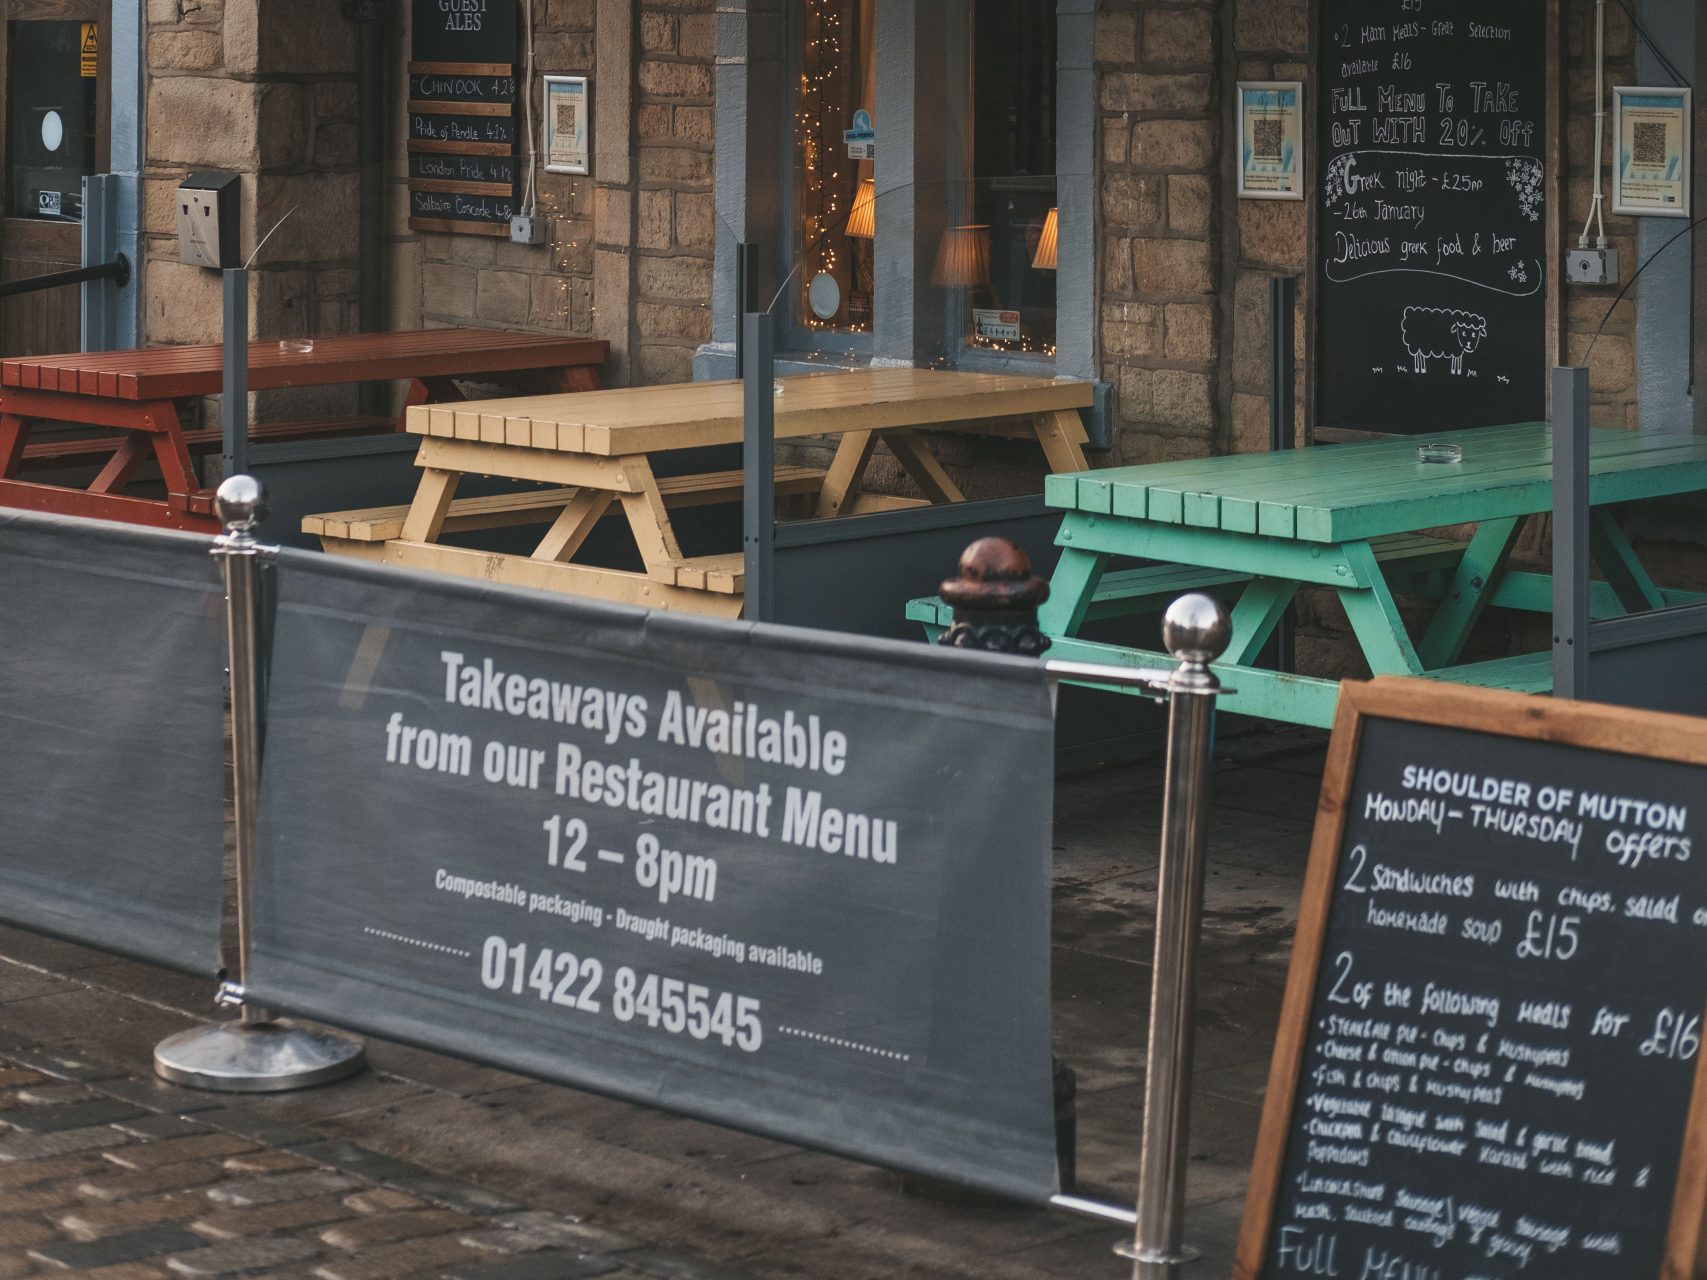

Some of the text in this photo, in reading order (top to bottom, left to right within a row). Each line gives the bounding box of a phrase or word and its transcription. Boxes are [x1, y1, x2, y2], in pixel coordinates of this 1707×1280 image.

[445, 13, 482, 31] ALES
[1341, 24, 1351, 48] 2
[1341, 51, 1412, 79] available £16
[1378, 84, 1426, 113] MENU
[1470, 82, 1520, 113] TAKE
[415, 116, 436, 137] Pride
[1372, 116, 1425, 144] WITH
[1439, 117, 1486, 146] 20%
[420, 156, 454, 176] London
[1374, 199, 1425, 229] January
[1333, 230, 1390, 263] Delicious
[1472, 232, 1482, 256] &
[440, 651, 847, 776] Takeaways Available
[385, 713, 898, 864] from our Restaurant Menu
[1402, 764, 1687, 833] SHOULDER OF MUTTON
[542, 815, 588, 872] 12
[634, 832, 718, 903] 8pm
[1344, 844, 1367, 893] 2
[1494, 880, 1540, 902] with
[435, 868, 823, 975] Compostable packaging Draught packaging available
[1516, 909, 1581, 961] £15
[480, 935, 763, 1053] 01422 845545
[1328, 950, 1353, 1004] 2
[1353, 982, 1374, 1010] of
[1384, 982, 1412, 1008] the
[1420, 981, 1500, 1028] following
[1639, 1006, 1700, 1061] £16
